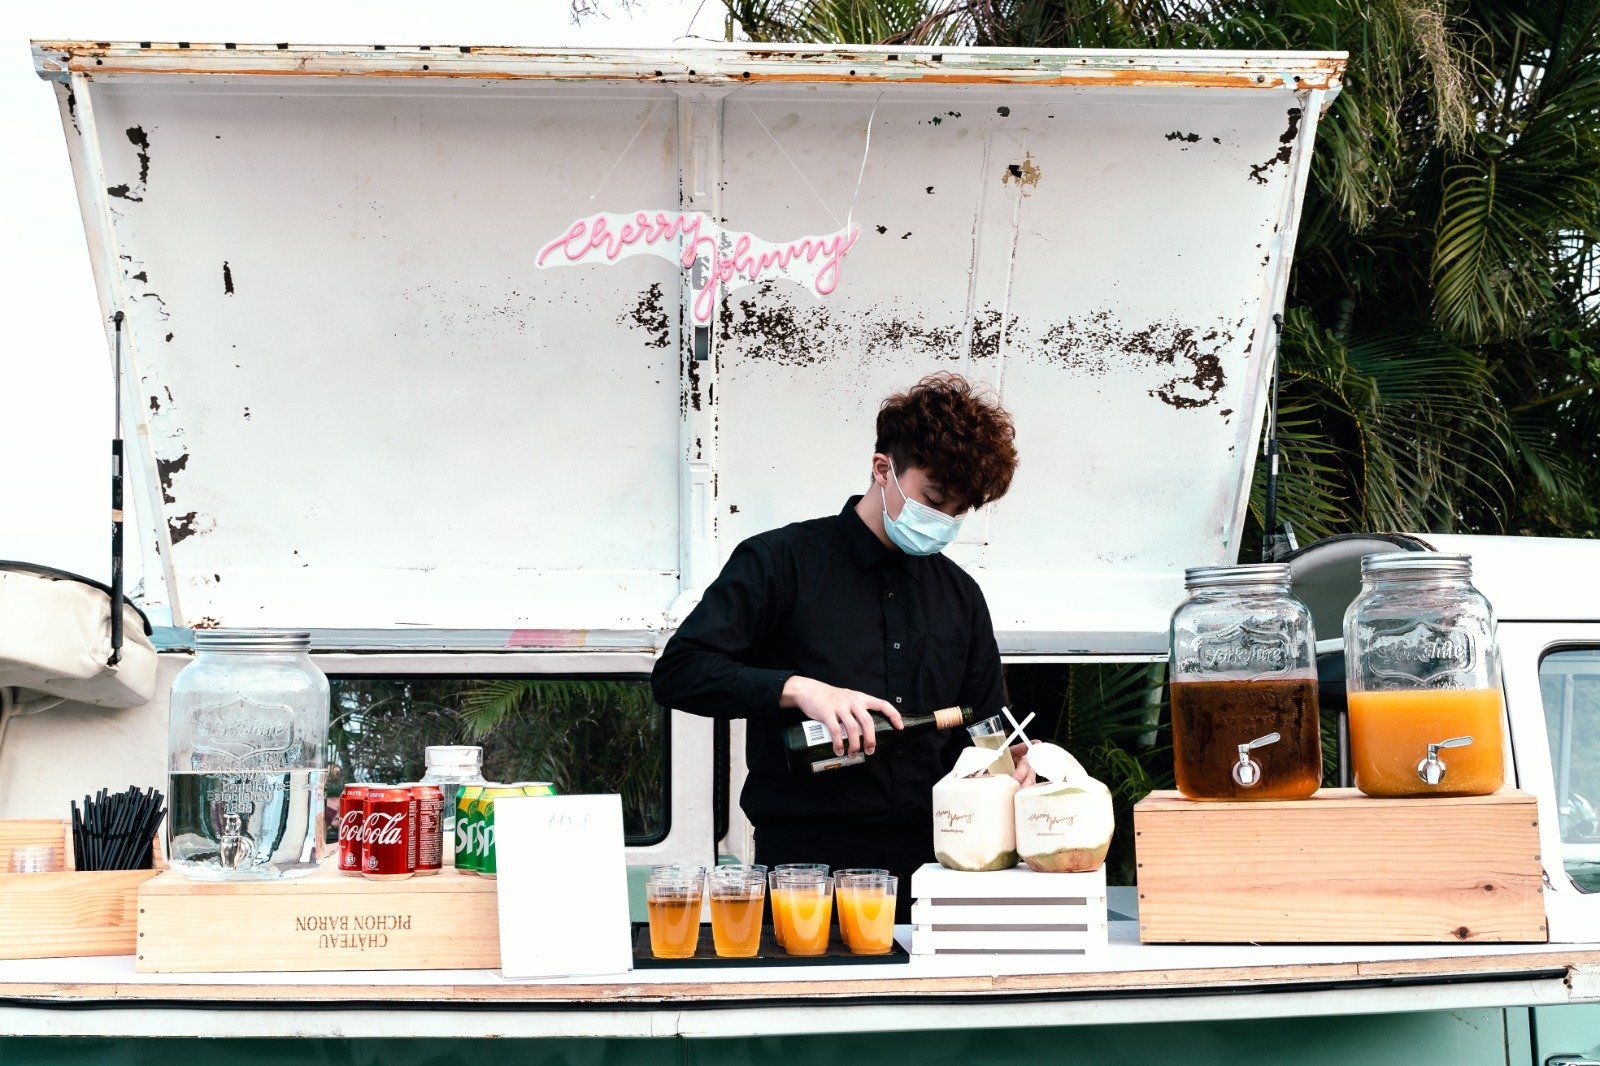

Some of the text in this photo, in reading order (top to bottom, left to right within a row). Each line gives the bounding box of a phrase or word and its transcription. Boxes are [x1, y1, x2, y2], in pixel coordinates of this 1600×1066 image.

[538, 212, 702, 270] Cherry
[693, 222, 862, 322] Johnny
[295, 915, 412, 931] PICHON BARON
